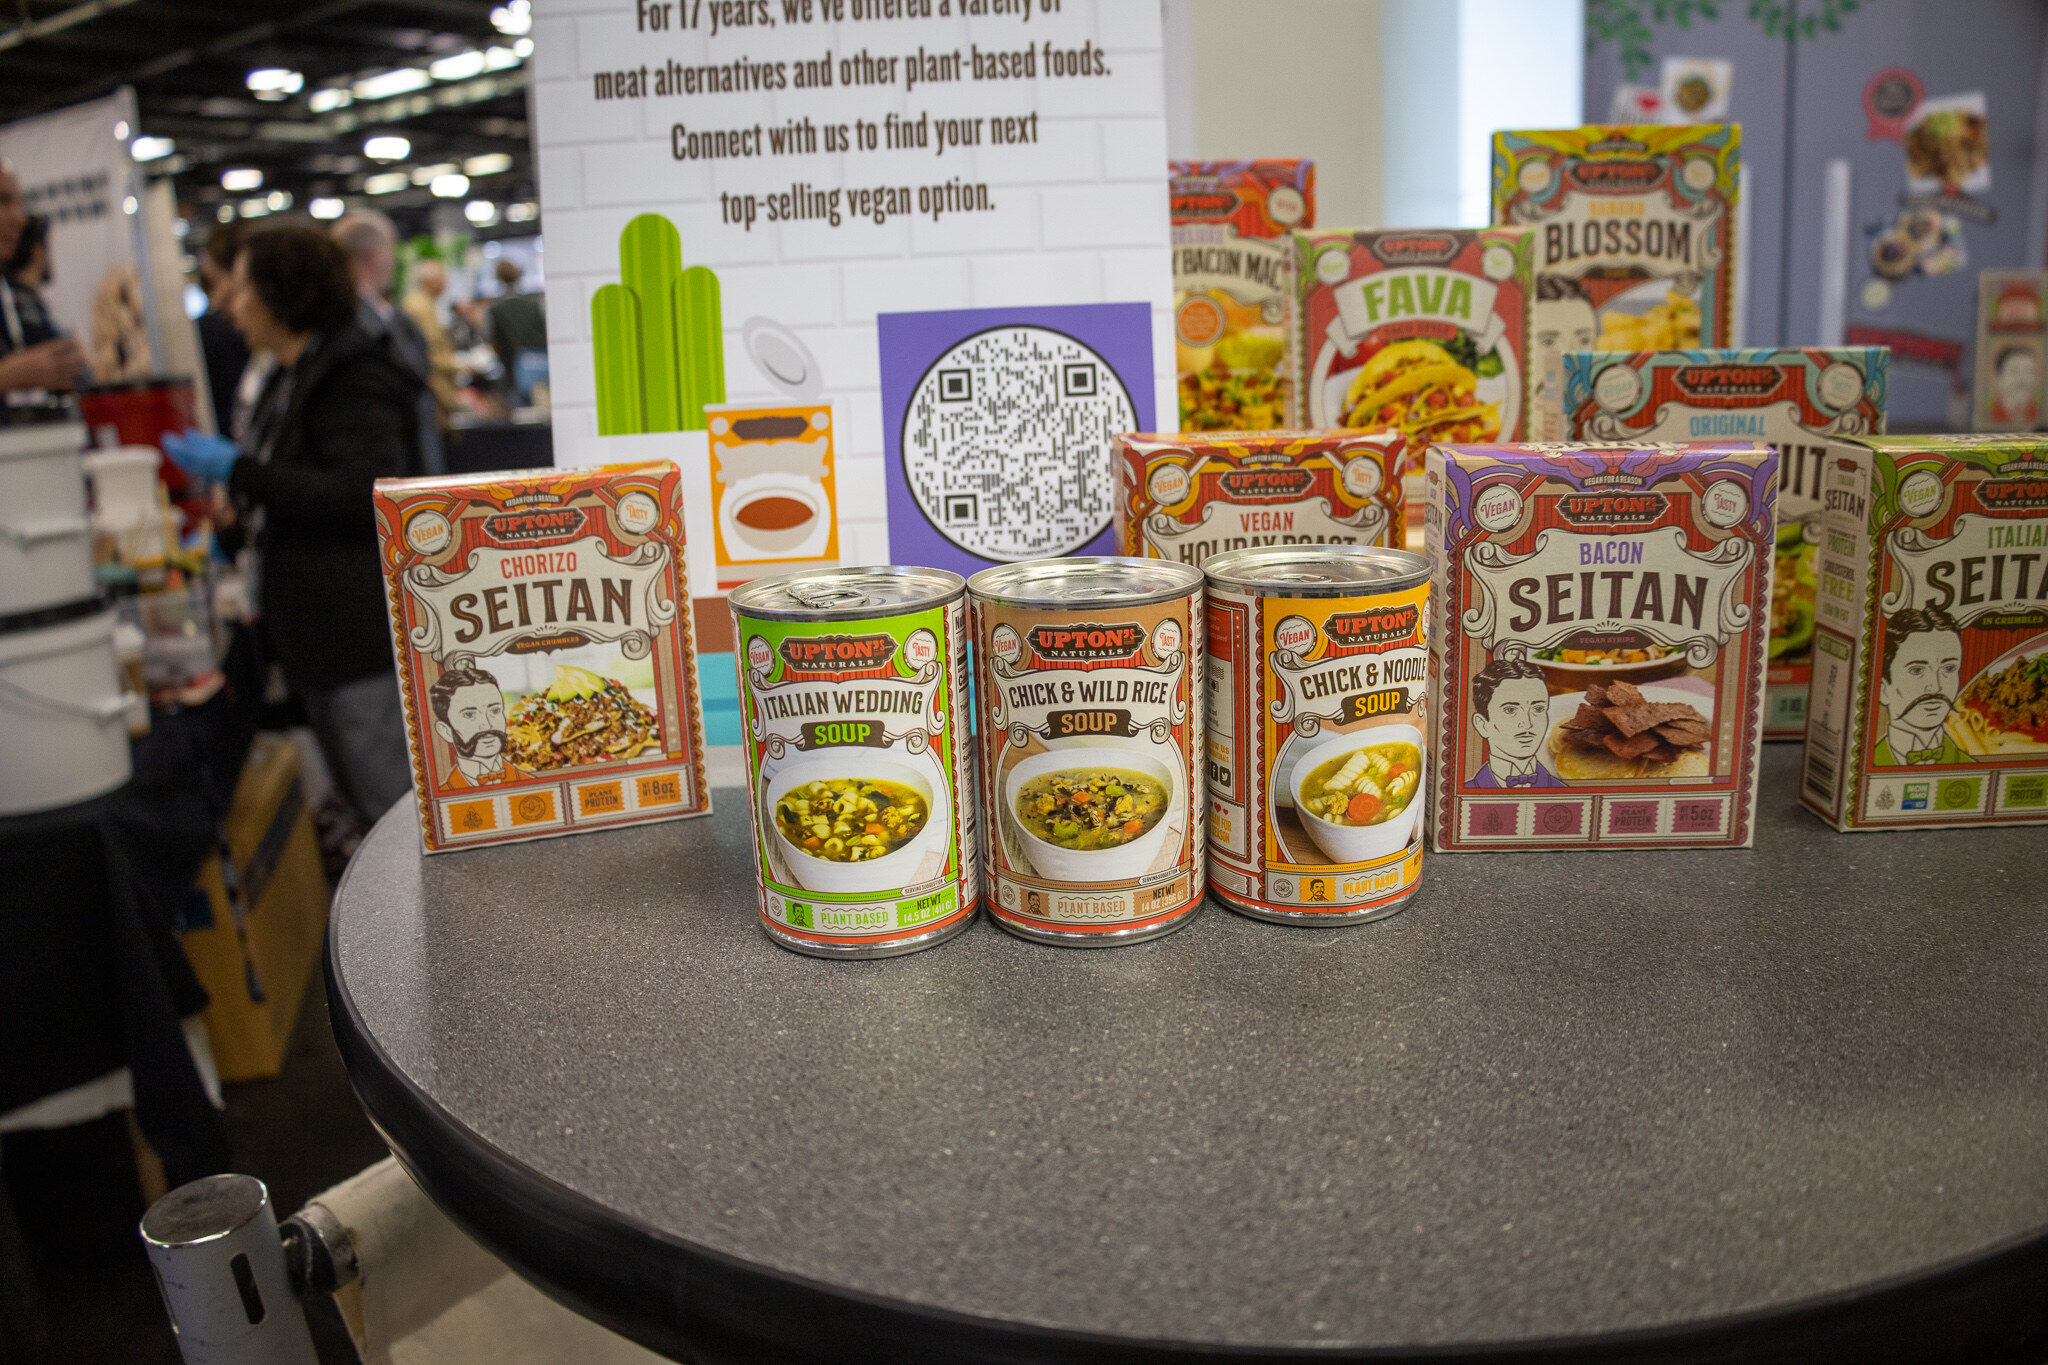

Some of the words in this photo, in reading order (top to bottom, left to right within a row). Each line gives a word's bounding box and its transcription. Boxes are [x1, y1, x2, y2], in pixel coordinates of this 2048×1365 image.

[637, 0, 671, 32] For
[680, 0, 701, 29] 17
[709, 0, 776, 37] years,
[783, 0, 844, 24] weve
[594, 65, 648, 101] meat
[654, 56, 787, 96] alternatives
[793, 50, 833, 88] and
[840, 48, 898, 87] other
[905, 41, 1036, 92] plant-based
[1042, 39, 1112, 78] foods.
[671, 122, 762, 161] Connect
[768, 116, 818, 156] with
[824, 123, 850, 152] us
[855, 117, 878, 151] to
[884, 111, 928, 150] find
[935, 117, 984, 156] your
[990, 111, 1039, 145] next
[720, 182, 842, 232] top-selling
[846, 185, 912, 225] vegan
[918, 177, 995, 222] option.
[1545, 219, 1691, 265] BLOSSOM
[1182, 249, 1241, 275] BACON
[1361, 274, 1473, 323] FAVA
[1689, 415, 1767, 437] ORIGINAL
[1153, 477, 1184, 494] VEGAN
[1584, 476, 1603, 486] VEGAN
[1604, 475, 1615, 483] FOR
[1620, 475, 1642, 485] REASON
[1569, 496, 1657, 513] UPTON'S
[1714, 493, 1737, 513] TASTY
[1904, 485, 1936, 504] VEGAN
[626, 504, 649, 521] TASTY
[1480, 498, 1515, 519] VEGAN
[1825, 489, 1865, 521] SEITAN
[494, 512, 575, 532] UPTON'S
[1240, 511, 1294, 533] VEGAN
[411, 523, 444, 544] VEGAN
[505, 528, 567, 539] NATURALS
[1988, 525, 2048, 549] ITALIA
[1579, 541, 1644, 565] BACON
[501, 551, 578, 579] CHORIZO
[1822, 574, 1855, 603] FREE
[450, 578, 632, 644] SEITAN
[1508, 571, 1710, 633] SEITAN
[1335, 609, 1414, 635] UPTON'S
[1994, 615, 2044, 626] CRUMBLES
[515, 640, 540, 649] VEGAN
[541, 636, 580, 647] CRUMBLES
[994, 638, 1017, 653] VEGAN
[1038, 628, 1135, 648] UPTON'S
[1159, 632, 1176, 648] TASTY
[1279, 629, 1310, 647] VEGAN
[1348, 629, 1407, 643] NATURALS
[750, 650, 770, 664] VEGAN
[788, 639, 885, 660] UPTON'S
[912, 641, 931, 658] TASTY
[1051, 648, 1124, 657] NATURALS
[801, 659, 874, 669] NATURALS
[1300, 665, 1363, 700] CHICK
[1366, 662, 1379, 687] &
[1383, 657, 1426, 685] NOODLE
[763, 691, 829, 720] ITALIAN
[833, 689, 923, 715] WEDDING
[1008, 681, 1058, 709] CHICK
[1060, 681, 1075, 704] &
[1078, 680, 1129, 703] WILD
[1132, 680, 1169, 704] RICE
[1355, 691, 1401, 718] SOUP
[1060, 712, 1118, 734] SOUP
[814, 722, 871, 745] SOUP
[588, 789, 613, 799] PLANT
[1907, 785, 1928, 794] NON
[2009, 788, 2044, 800] PROTEIN
[584, 796, 619, 809] PROTEIN
[1614, 815, 1651, 827] PROTEIN
[1141, 873, 1158, 884] SERVING
[1158, 868, 1178, 881] SUGGESTION
[1343, 879, 1373, 895] PLANT
[1375, 871, 1399, 890] BASED
[916, 897, 930, 910] NET
[930, 893, 942, 905] WT
[1152, 888, 1165, 900] NET
[1165, 883, 1176, 895] WT
[903, 911, 920, 923] 14.5
[920, 907, 931, 919] OZ
[1057, 902, 1089, 914] PLANT
[1093, 900, 1126, 914] BASED
[1141, 902, 1150, 912] 14
[1150, 899, 1160, 910] OZ
[820, 911, 852, 925] PLANT
[855, 910, 889, 924] BASED
